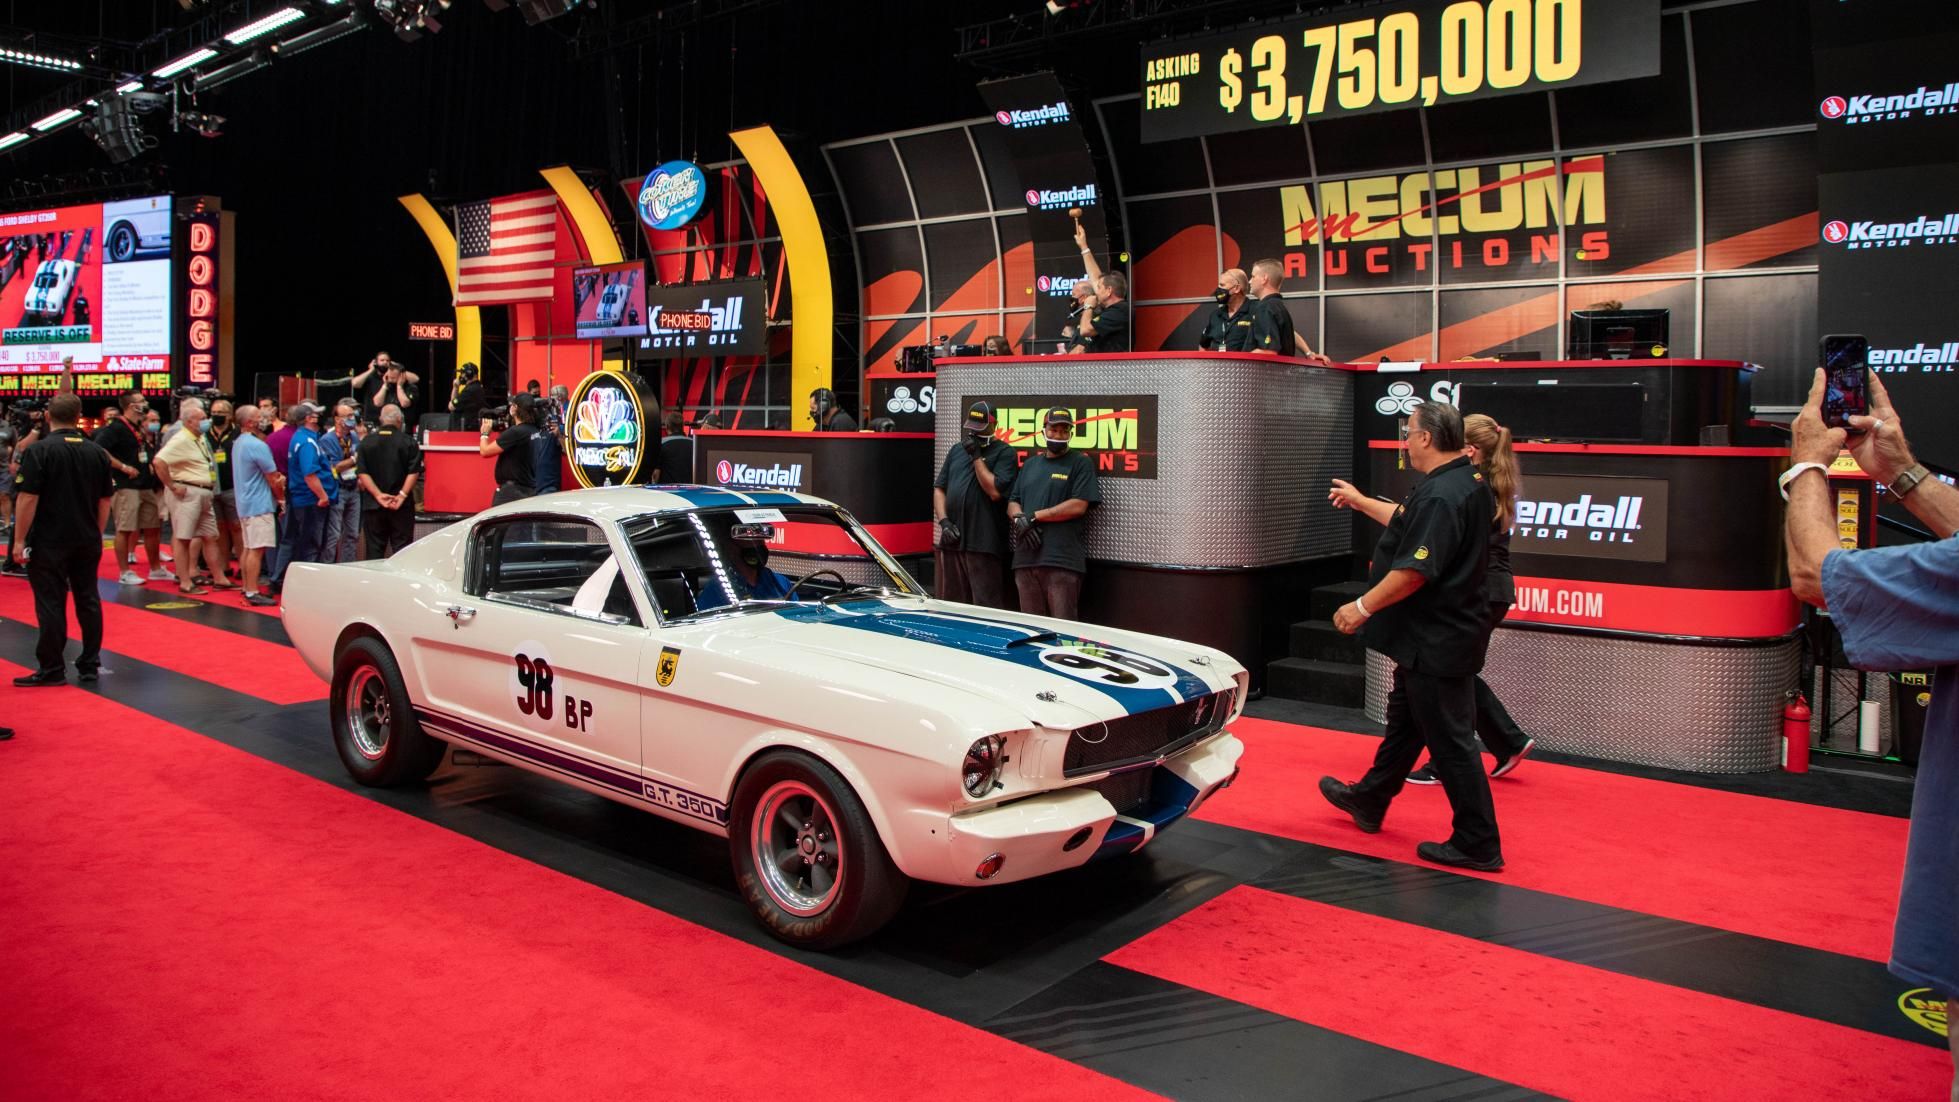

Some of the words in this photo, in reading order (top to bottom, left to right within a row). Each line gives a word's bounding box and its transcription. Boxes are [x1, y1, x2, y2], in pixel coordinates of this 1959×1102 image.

[1146, 53, 1200, 82] ASKING
[1146, 82, 1180, 110] F140
[1847, 82, 1959, 116] Kendall
[1010, 102, 1068, 123] Kendall
[1014, 119, 1047, 129] MOTOR
[1846, 111, 1911, 125] MOTOR
[1925, 106, 1958, 116] OIL
[1040, 184, 1096, 204] Kendall
[1280, 154, 1606, 247] MECUM
[1041, 202, 1073, 210] MOTOR
[1848, 213, 1959, 241] Kendall
[1847, 239, 1911, 250] MOTOR
[1925, 236, 1957, 245] OIL
[1284, 231, 1610, 279] AUCTIONS
[189, 222, 216, 384] DODGE
[411, 325, 439, 338] PHONE
[439, 326, 453, 339] BID
[661, 313, 693, 329] PHONE
[694, 314, 711, 329] BID
[4, 328, 52, 342] RESERVE
[55, 329, 65, 341] IS
[68, 327, 89, 341] OFF
[709, 333, 738, 345] OIL
[1868, 342, 1959, 365] endall
[1873, 365, 1908, 373] TOR
[22, 375, 73, 389] MECU
[78, 374, 133, 389] MECUM
[732, 463, 802, 487] Kendall
[1515, 494, 1643, 530] endall
[1510, 527, 1568, 539] TOR
[1589, 531, 1634, 543] OIL
[1510, 586, 1604, 618] UM.COM
[1044, 647, 1171, 685] 98
[515, 653, 554, 720] 98
[1903, 676, 1924, 685] NR
[565, 695, 593, 733] BP
[676, 794, 715, 818] 350
